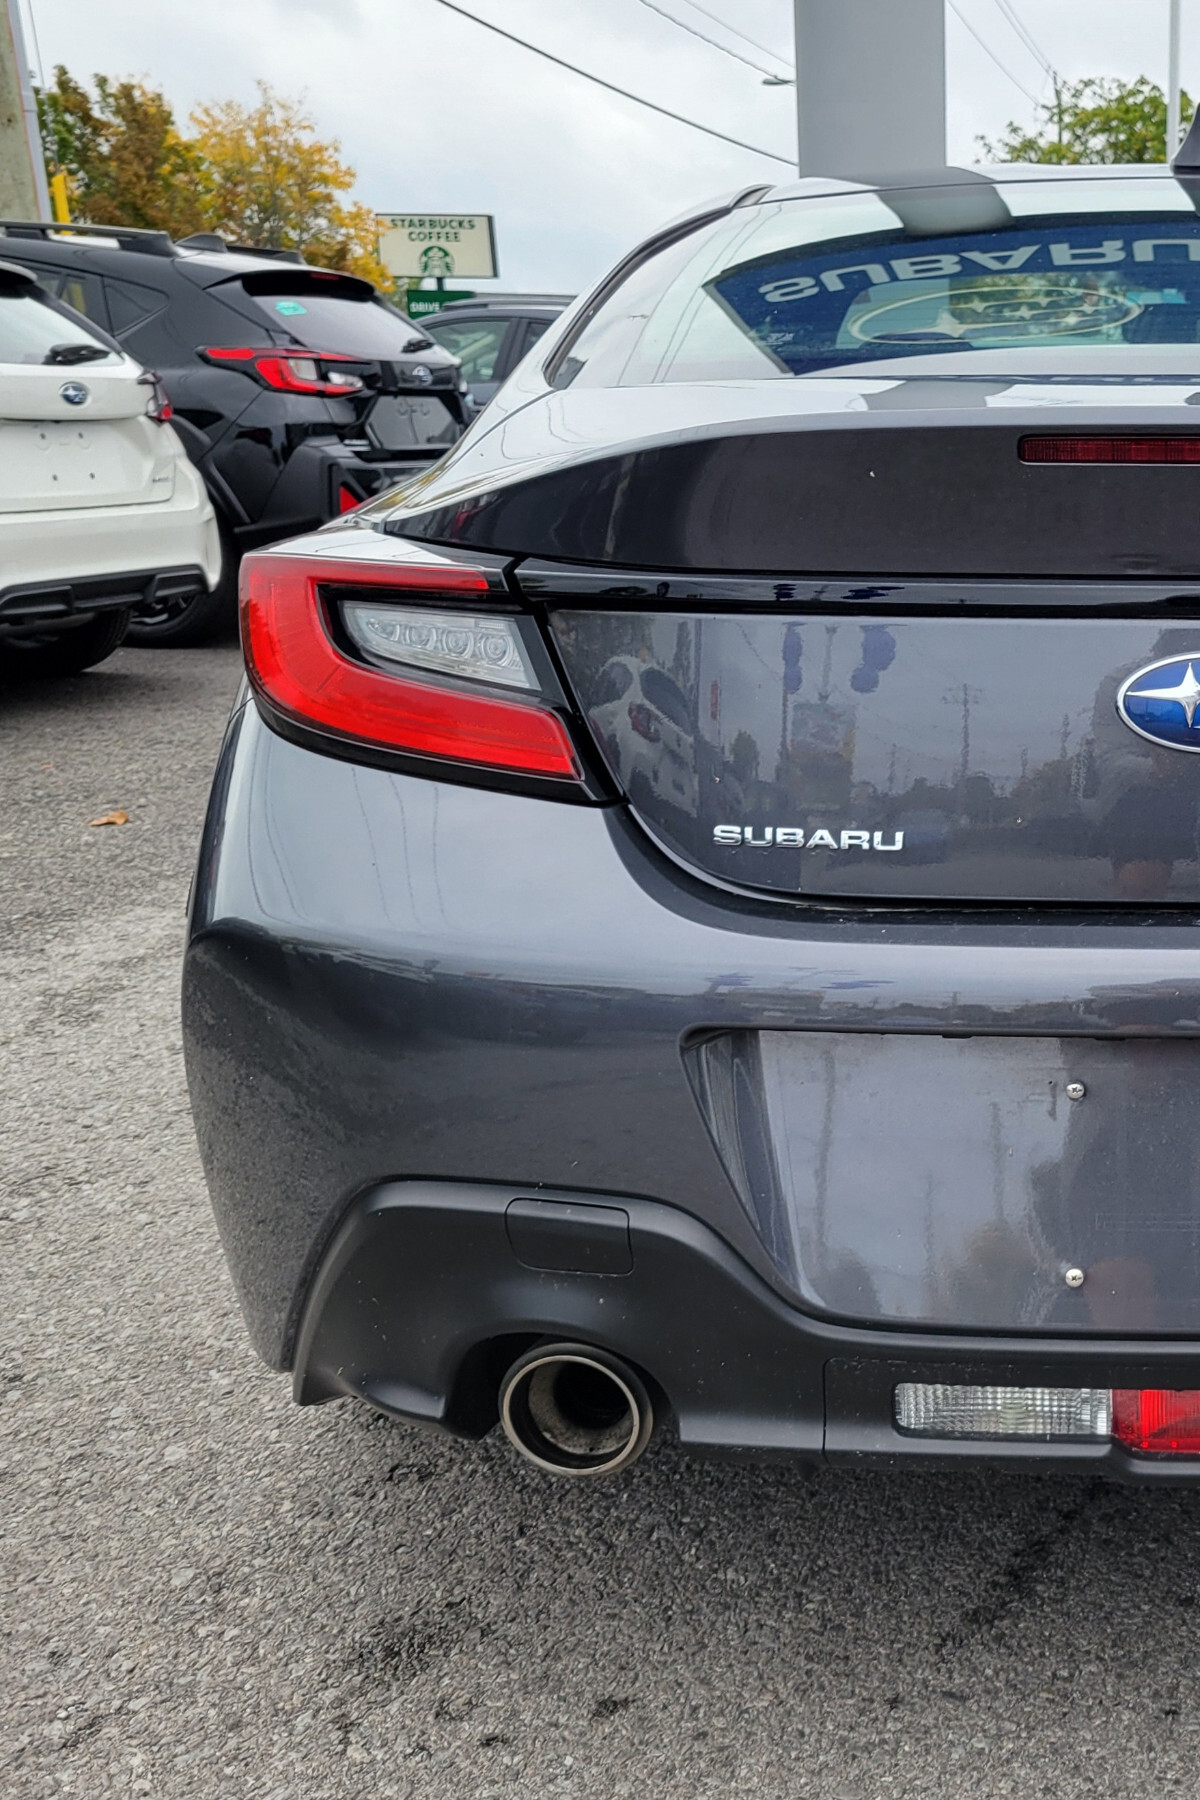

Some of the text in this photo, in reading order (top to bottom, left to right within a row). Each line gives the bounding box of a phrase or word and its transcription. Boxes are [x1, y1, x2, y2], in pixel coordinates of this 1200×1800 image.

[390, 218, 476, 230] STARBUCKS
[408, 231, 461, 242] COFFEE
[713, 824, 904, 851] SUBARU
